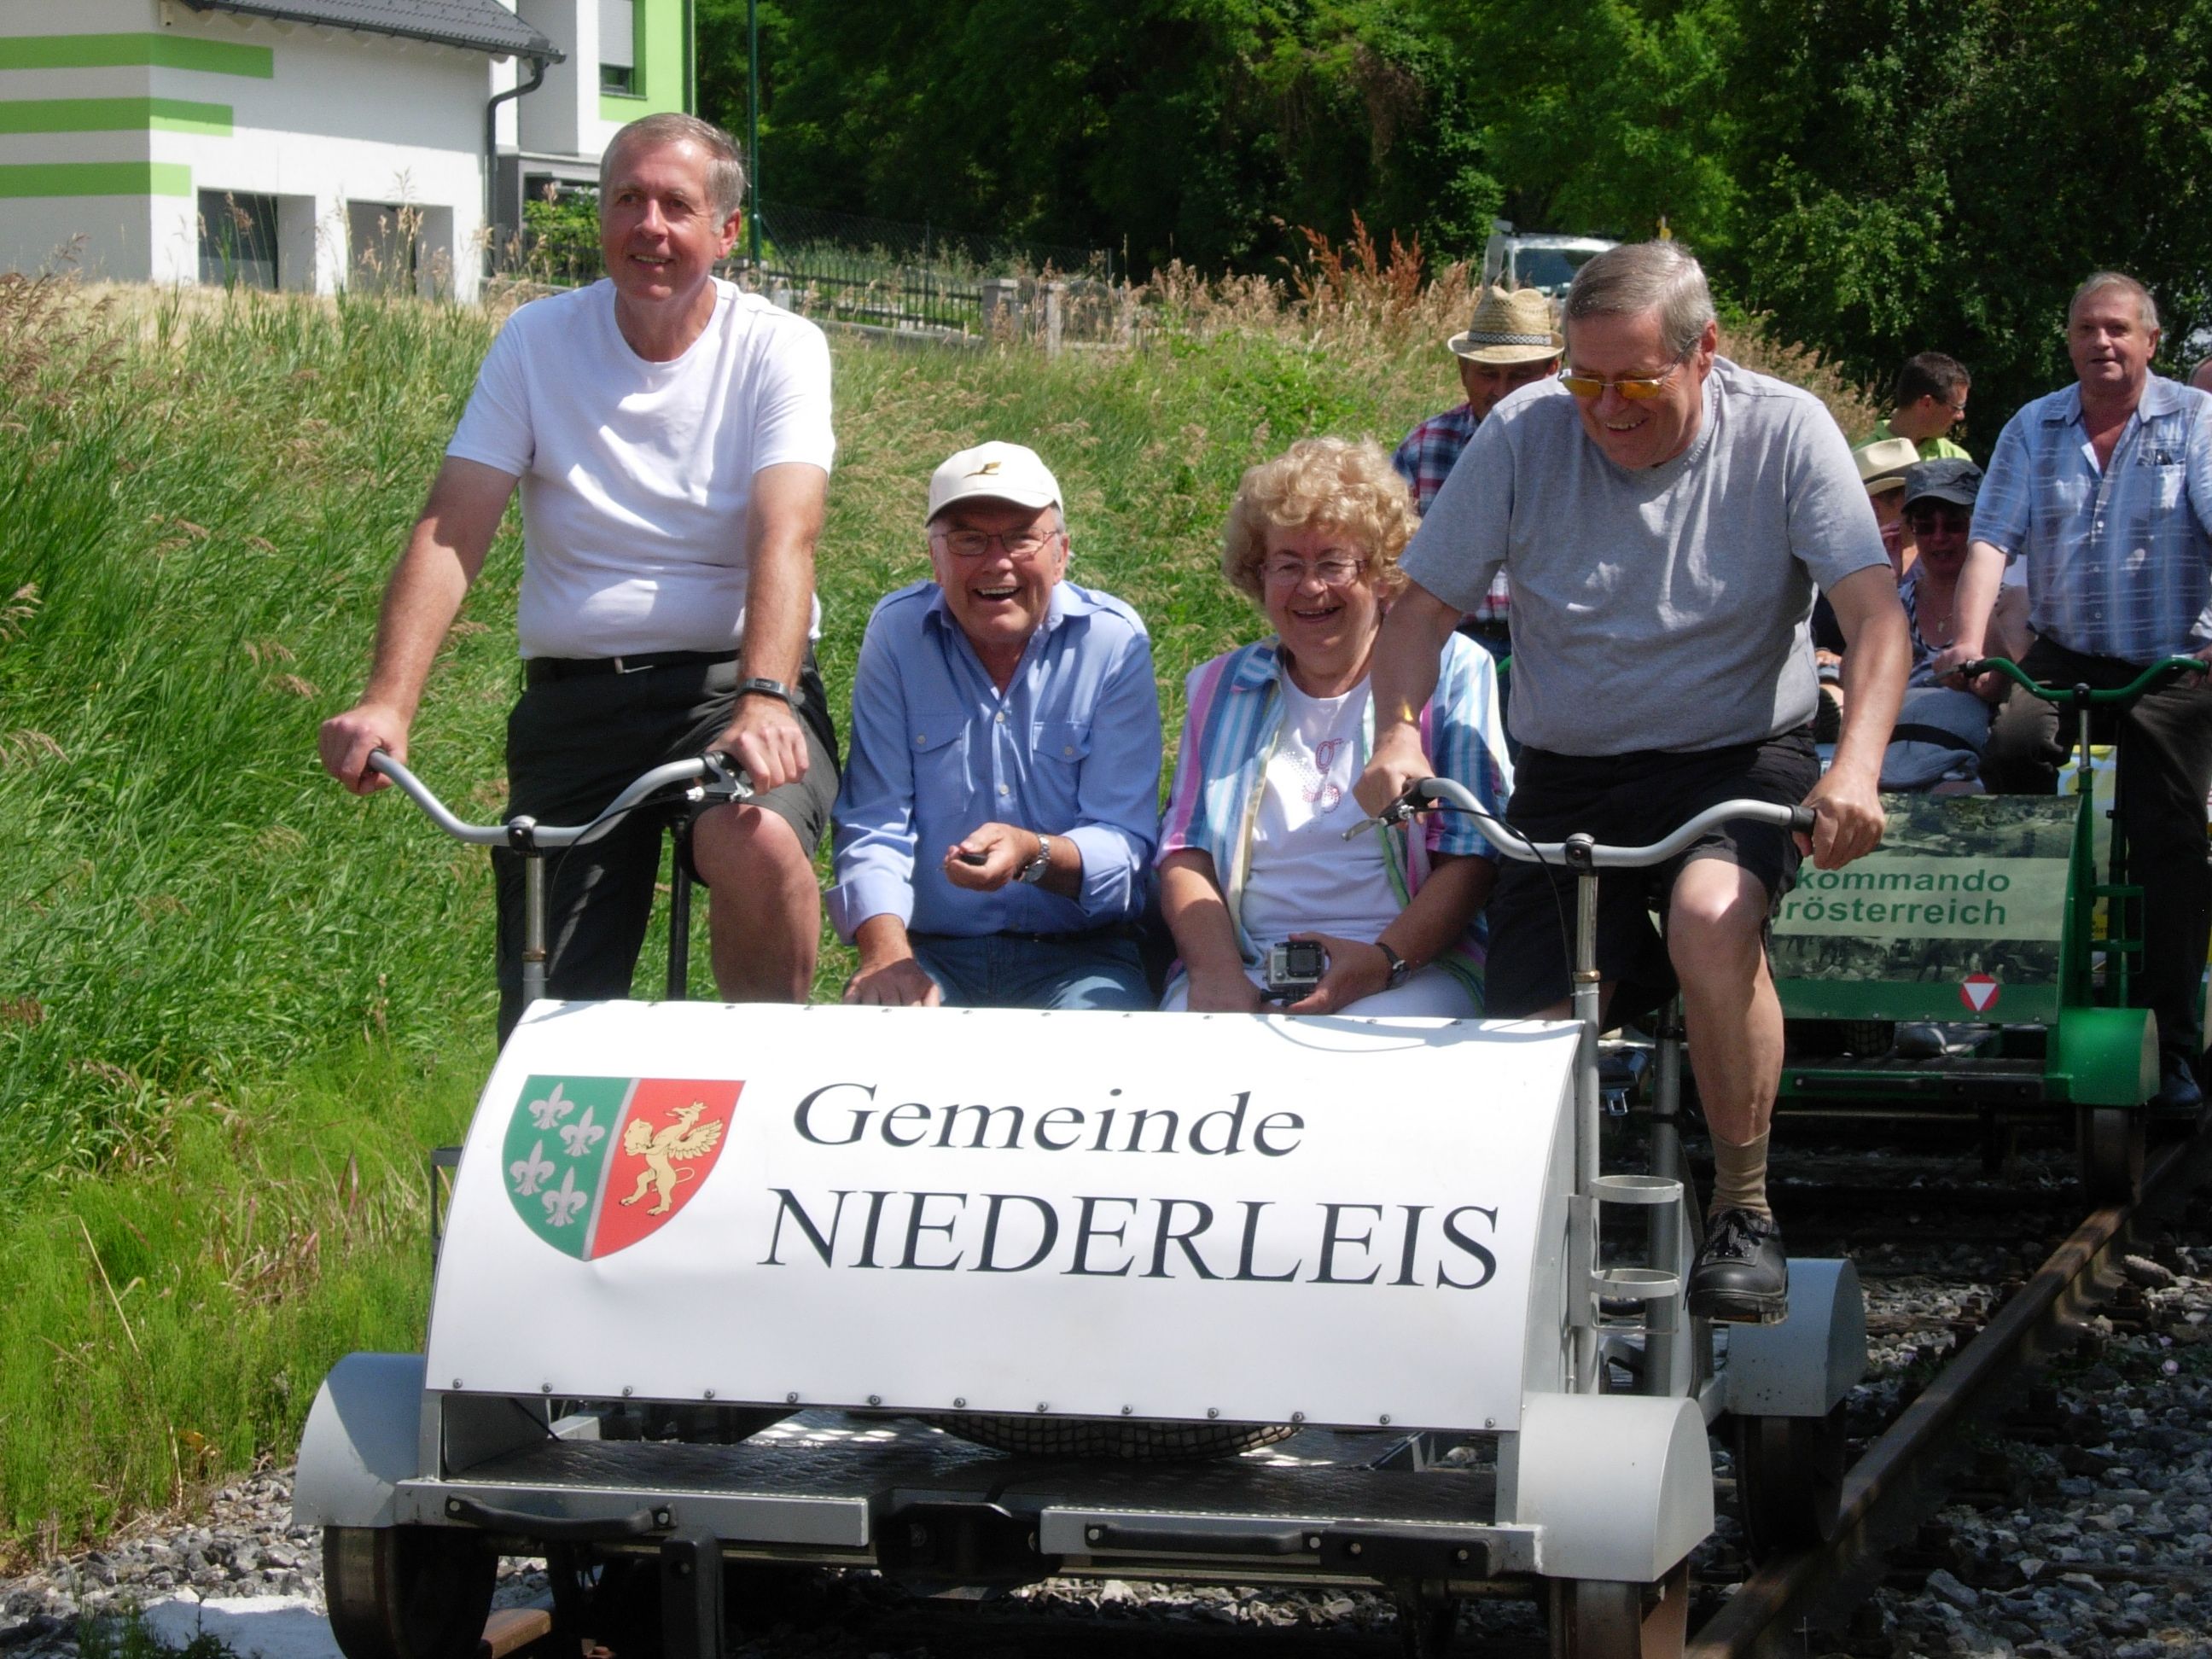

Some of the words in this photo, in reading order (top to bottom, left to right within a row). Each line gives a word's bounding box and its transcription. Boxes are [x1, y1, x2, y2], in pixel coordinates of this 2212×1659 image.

[1796, 865, 2011, 893] kommando
[1773, 896, 2006, 926] rösterreich
[794, 1083, 1305, 1156] Gemeinde
[757, 1188, 1499, 1290] NIEDERLEIS
